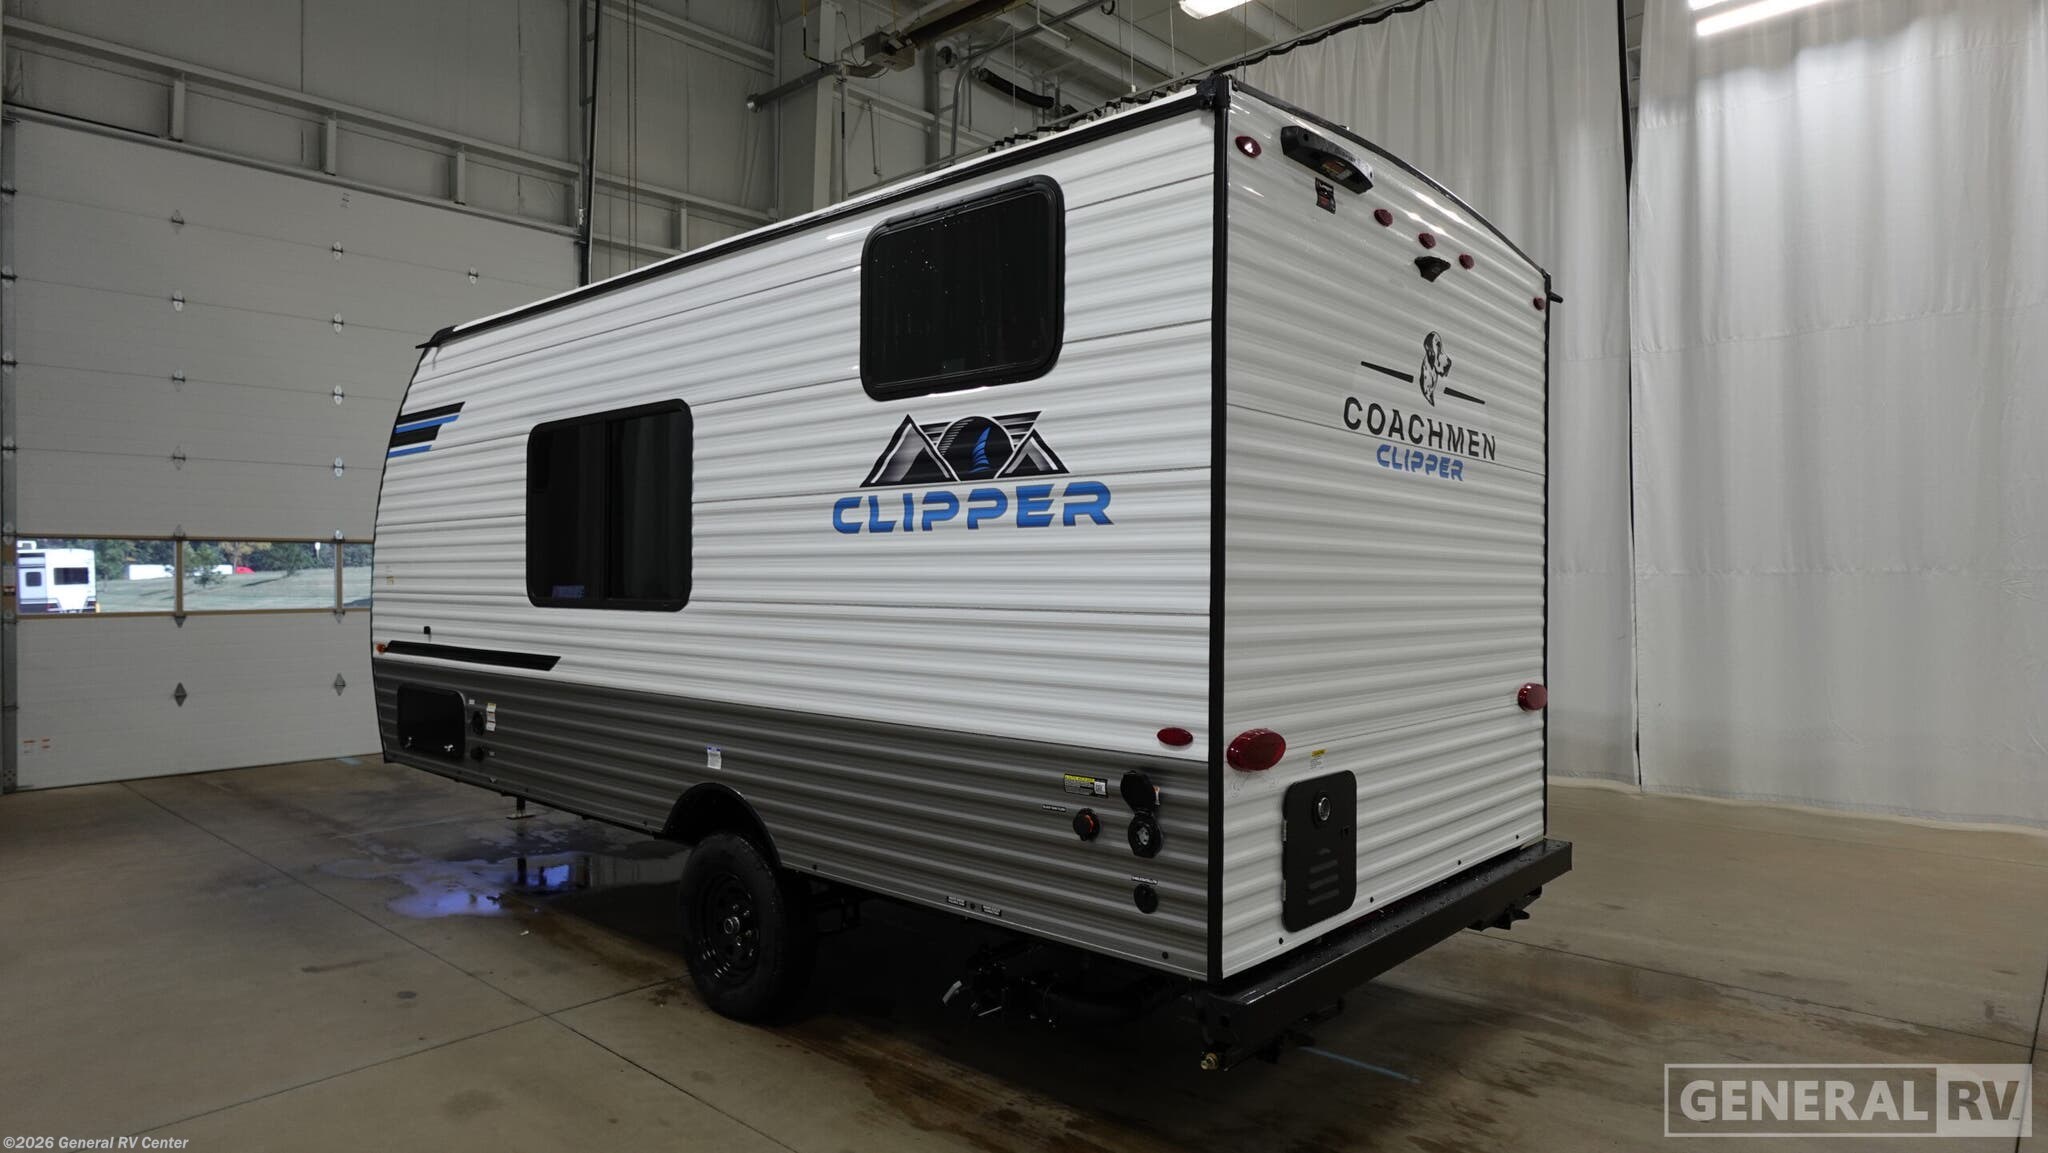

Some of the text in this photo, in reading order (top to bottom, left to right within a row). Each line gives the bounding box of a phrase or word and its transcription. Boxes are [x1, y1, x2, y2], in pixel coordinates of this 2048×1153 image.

[1343, 397, 1496, 461] COACHMEN
[1376, 444, 1464, 481] CLIPPER
[832, 481, 1114, 534] CLIPPER
